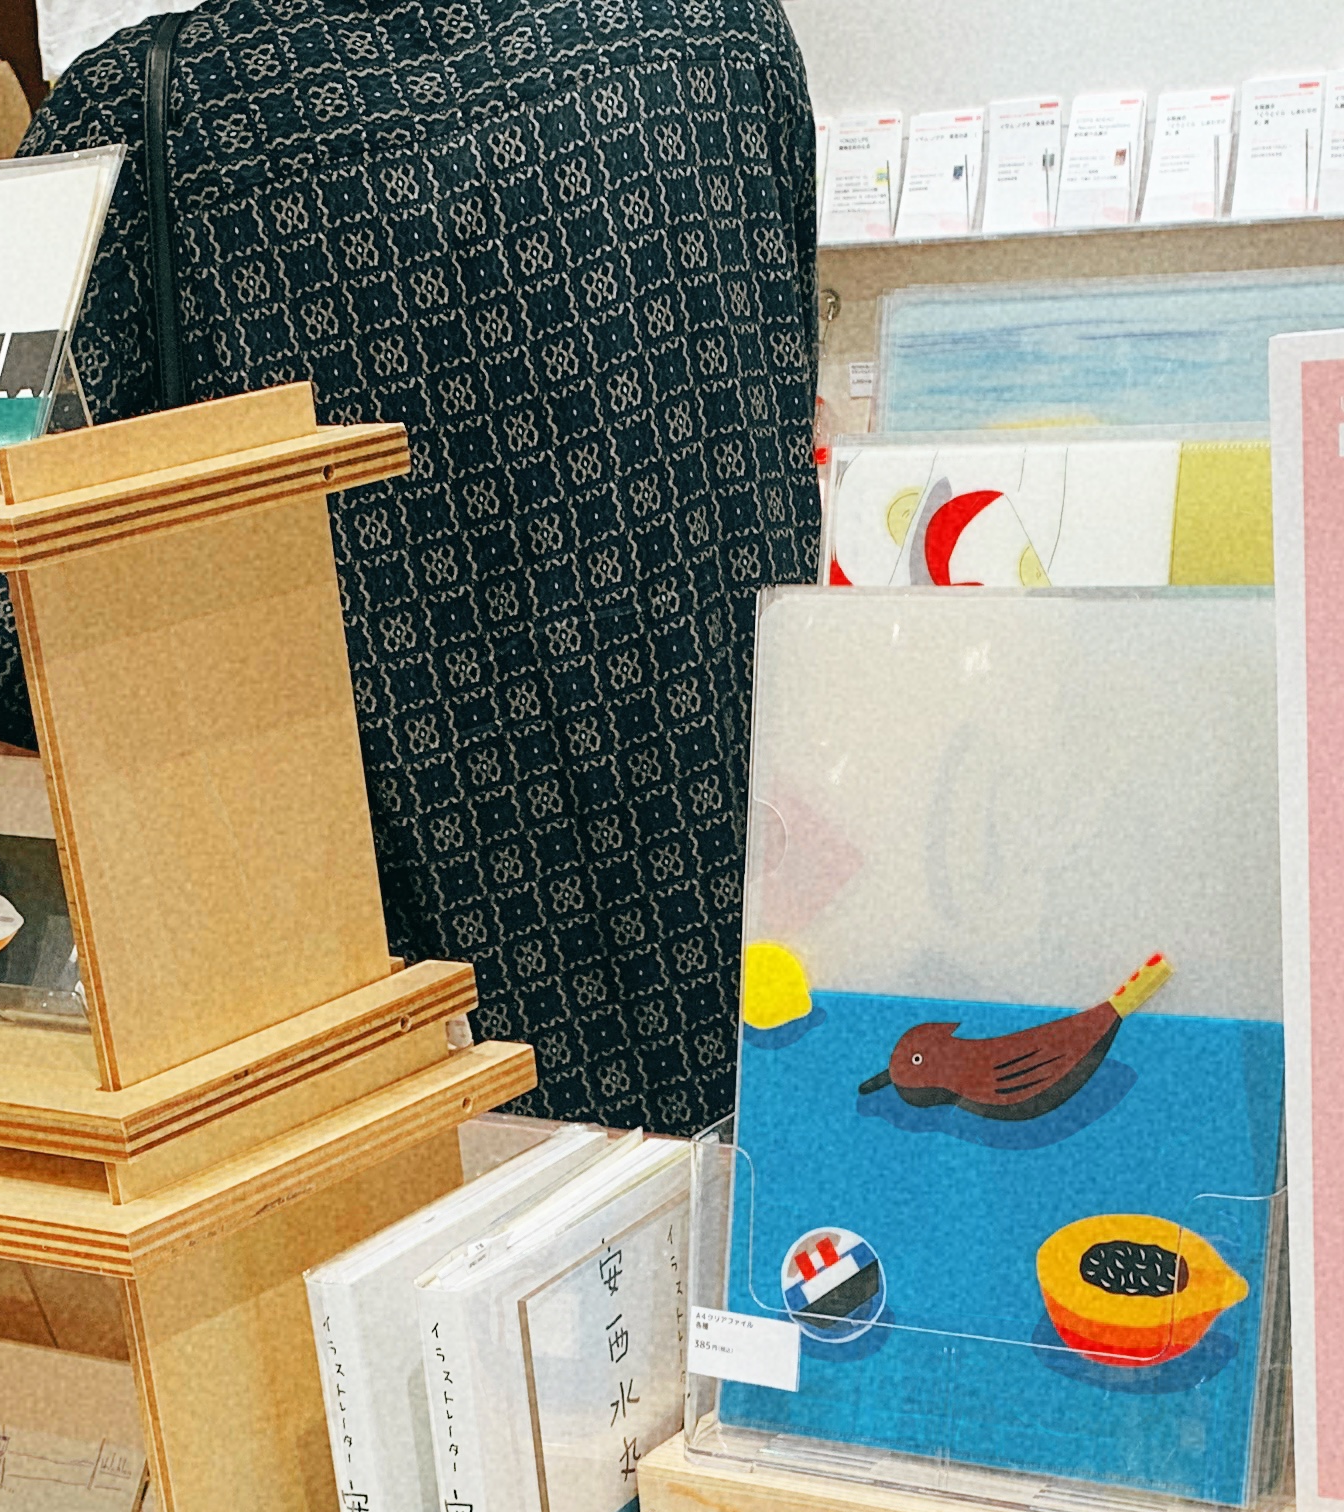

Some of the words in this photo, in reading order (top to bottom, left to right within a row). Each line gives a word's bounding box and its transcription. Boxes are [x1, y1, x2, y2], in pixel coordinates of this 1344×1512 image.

[322, 1315, 354, 1463] イラストレーター
[431, 1322, 460, 1473] イラストレーター
[598, 1236, 642, 1483] 安西水丸
